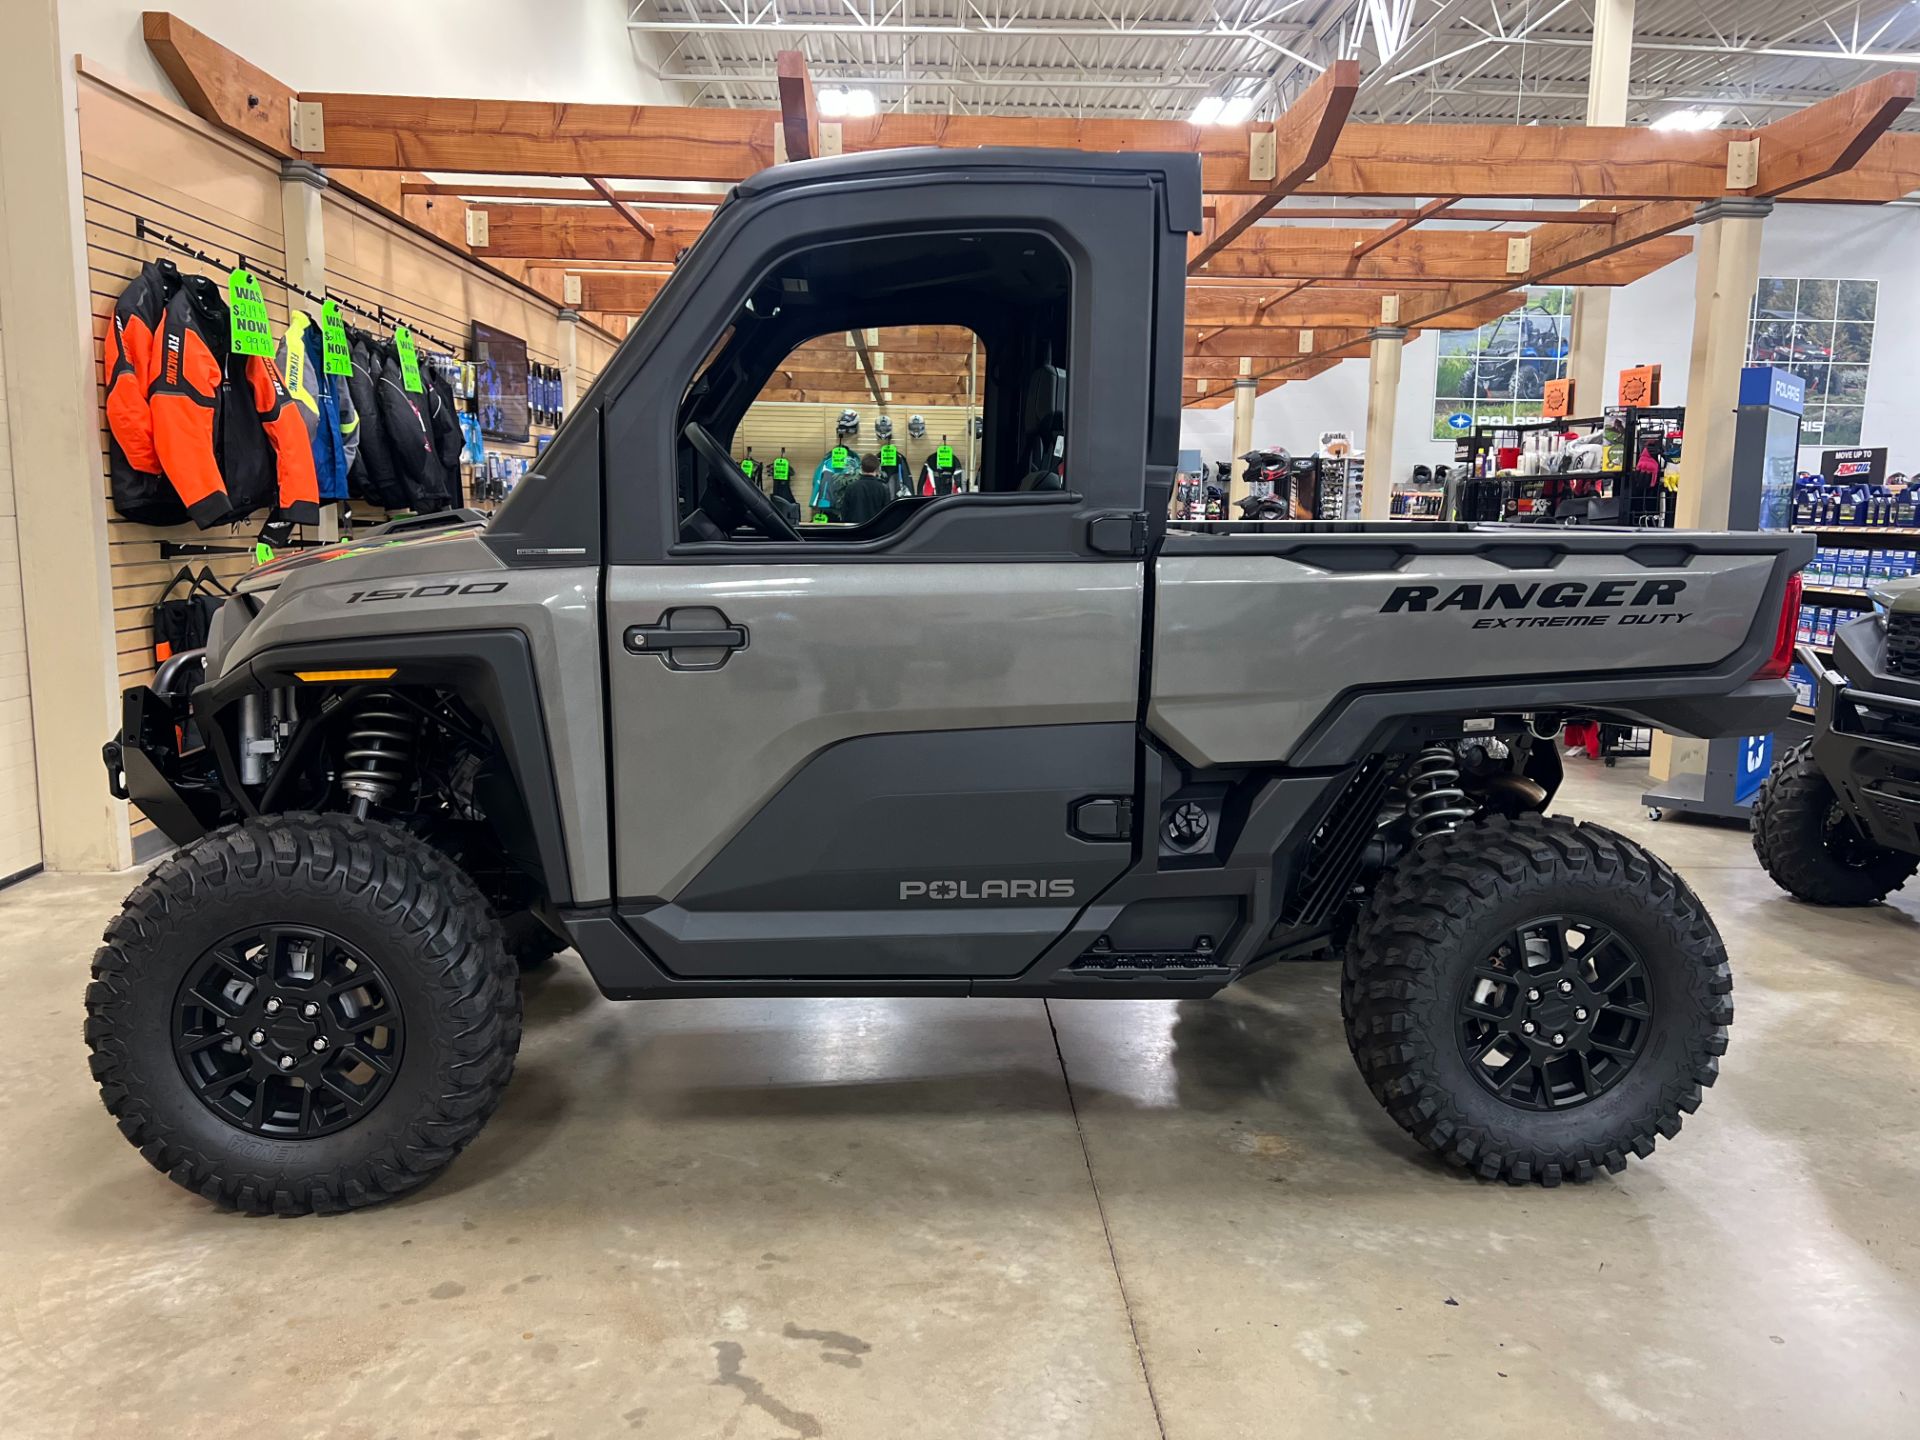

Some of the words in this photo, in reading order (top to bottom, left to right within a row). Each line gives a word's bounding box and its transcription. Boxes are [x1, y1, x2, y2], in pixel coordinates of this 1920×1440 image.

[235, 286, 262, 303] WAS
[236, 318, 267, 335] NOW
[168, 333, 180, 353] FLY
[327, 343, 348, 356] NOW
[166, 350, 178, 386] RACING
[1775, 380, 1800, 402] POLARIS
[1835, 451, 1853, 459] MOVE
[1853, 450, 1863, 458] UP
[1863, 450, 1872, 458] TO
[1835, 462, 1870, 475] AMSOIL
[346, 582, 508, 604] 1500
[1378, 580, 1687, 613] RANGER
[1471, 615, 1610, 629] EXTREME
[1617, 612, 1694, 626] DUTY
[900, 878, 1075, 900] POLARIS
